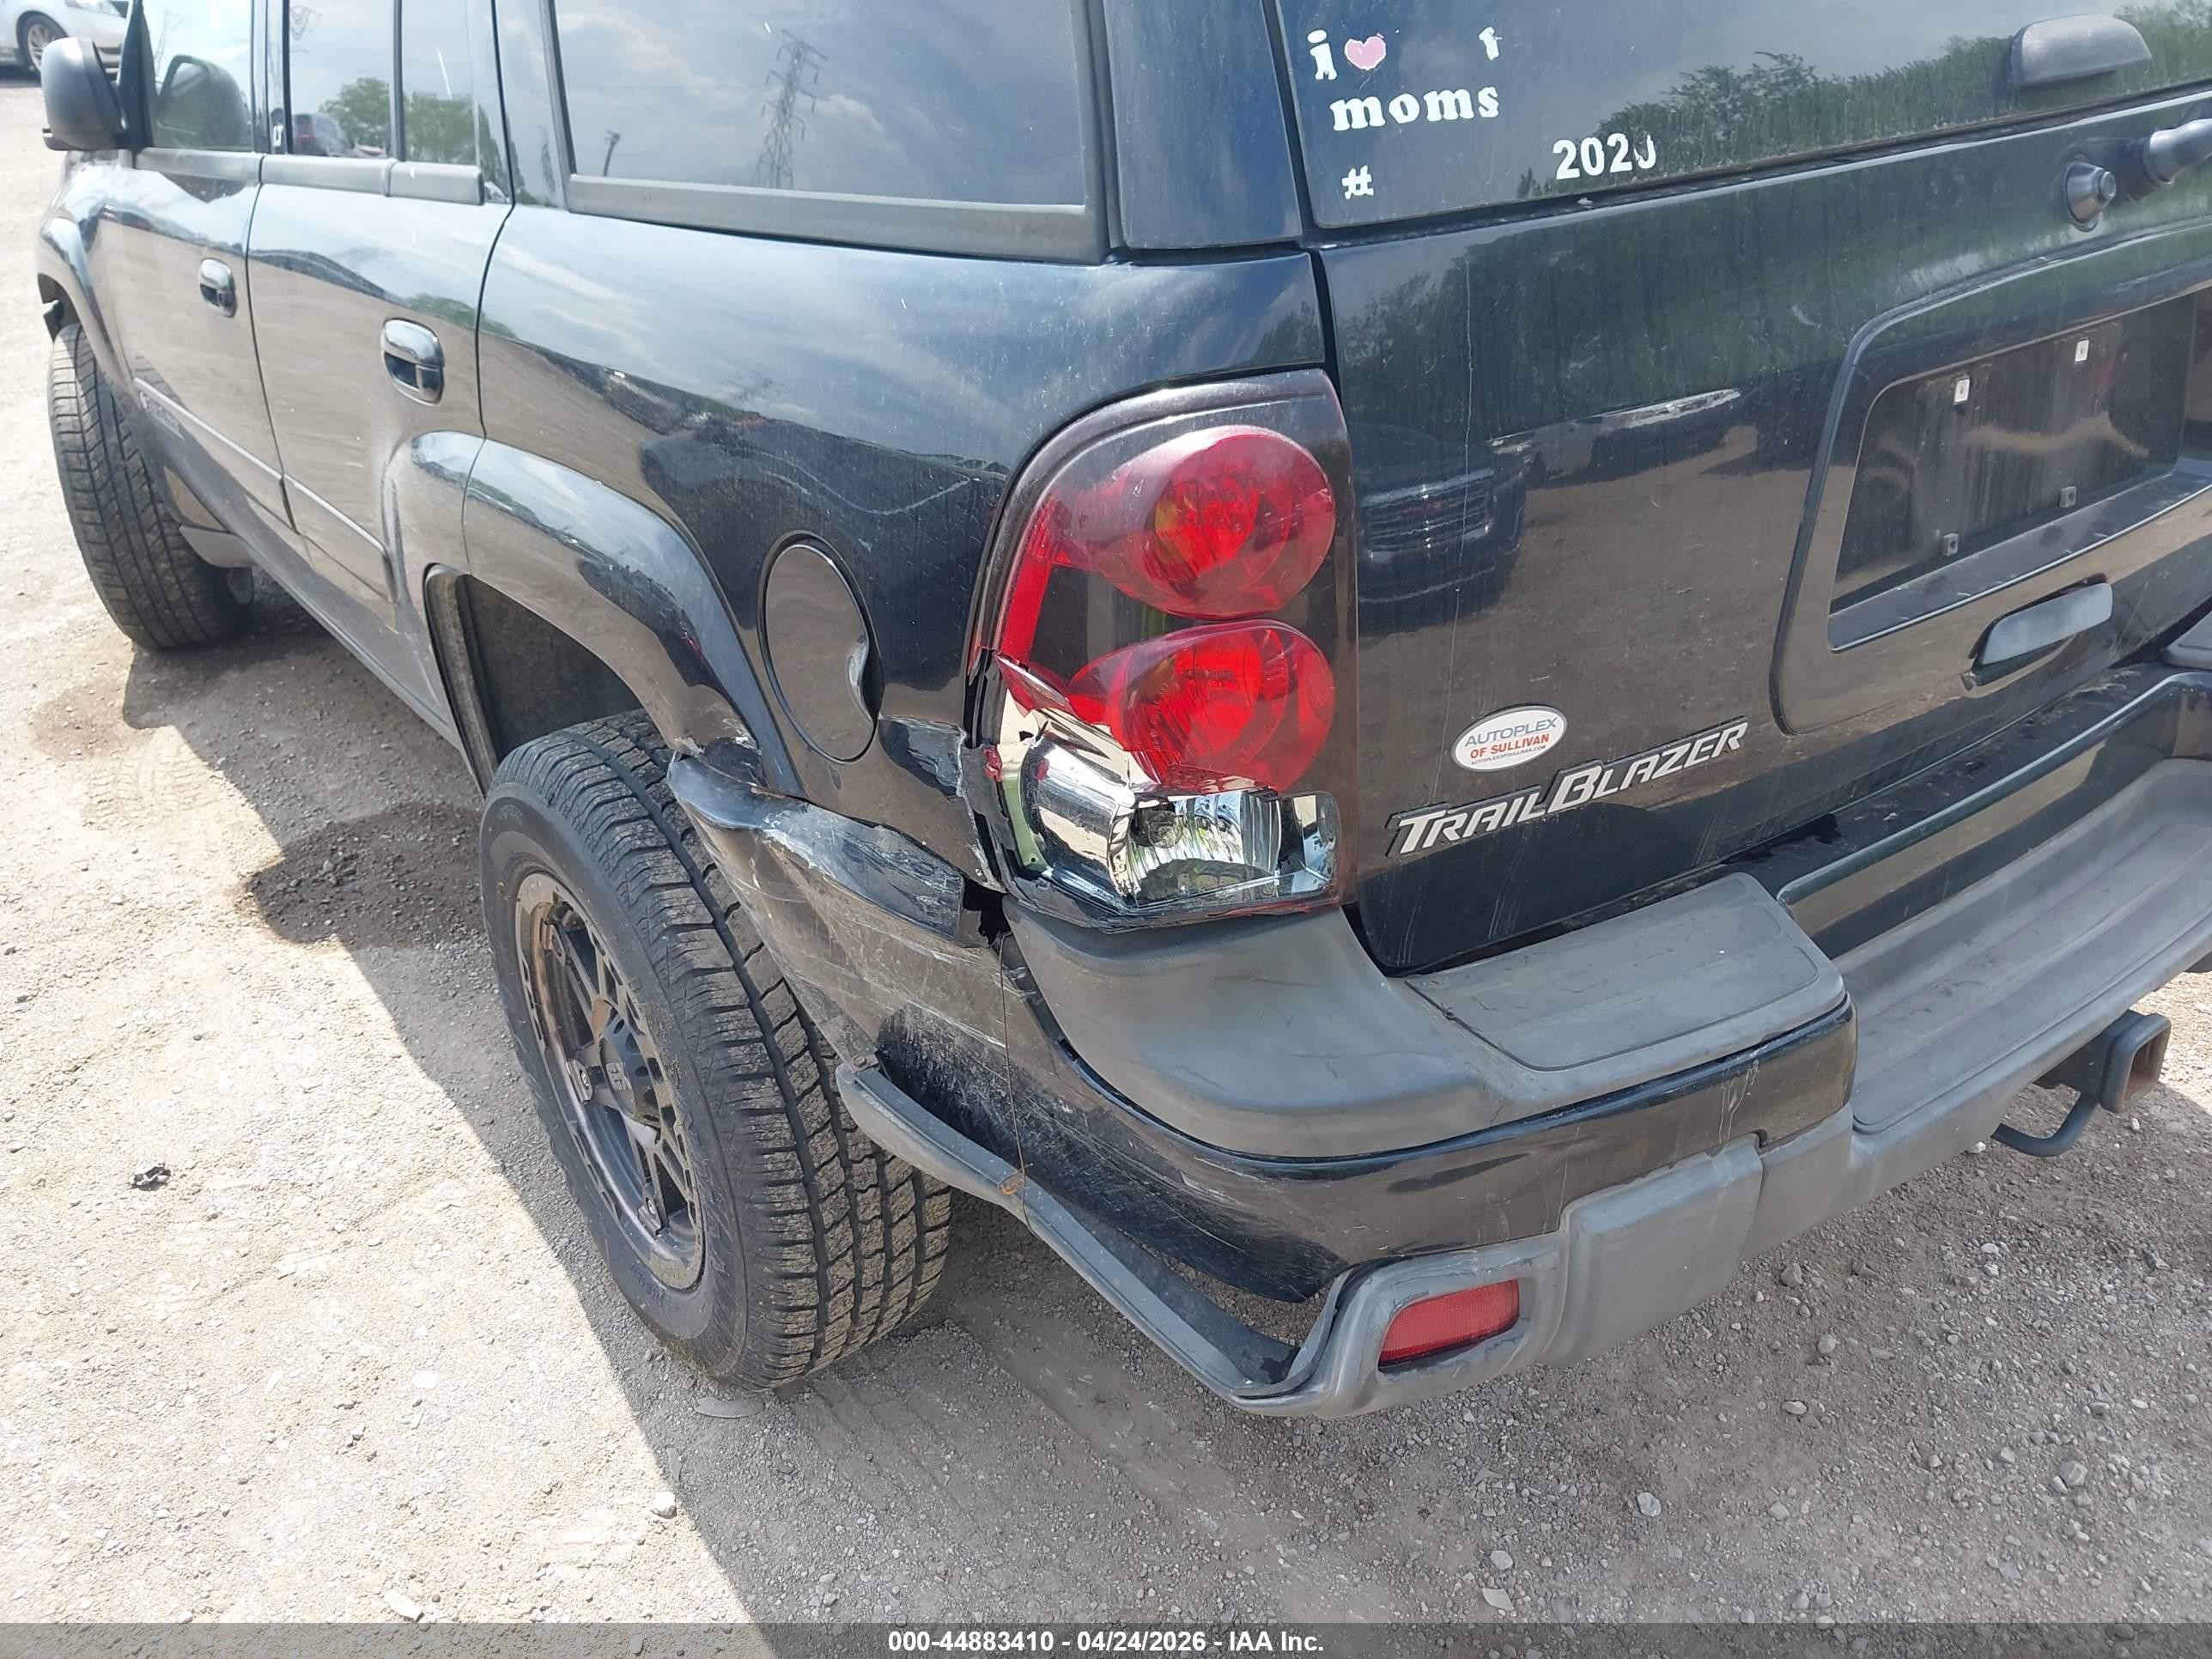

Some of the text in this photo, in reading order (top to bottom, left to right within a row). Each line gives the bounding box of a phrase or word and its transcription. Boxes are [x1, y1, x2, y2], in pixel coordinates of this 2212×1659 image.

[1329, 86, 1499, 131] moms
[1464, 717, 1559, 747] AUTOPLEX
[1469, 733, 1551, 759] OF SULLIVAN
